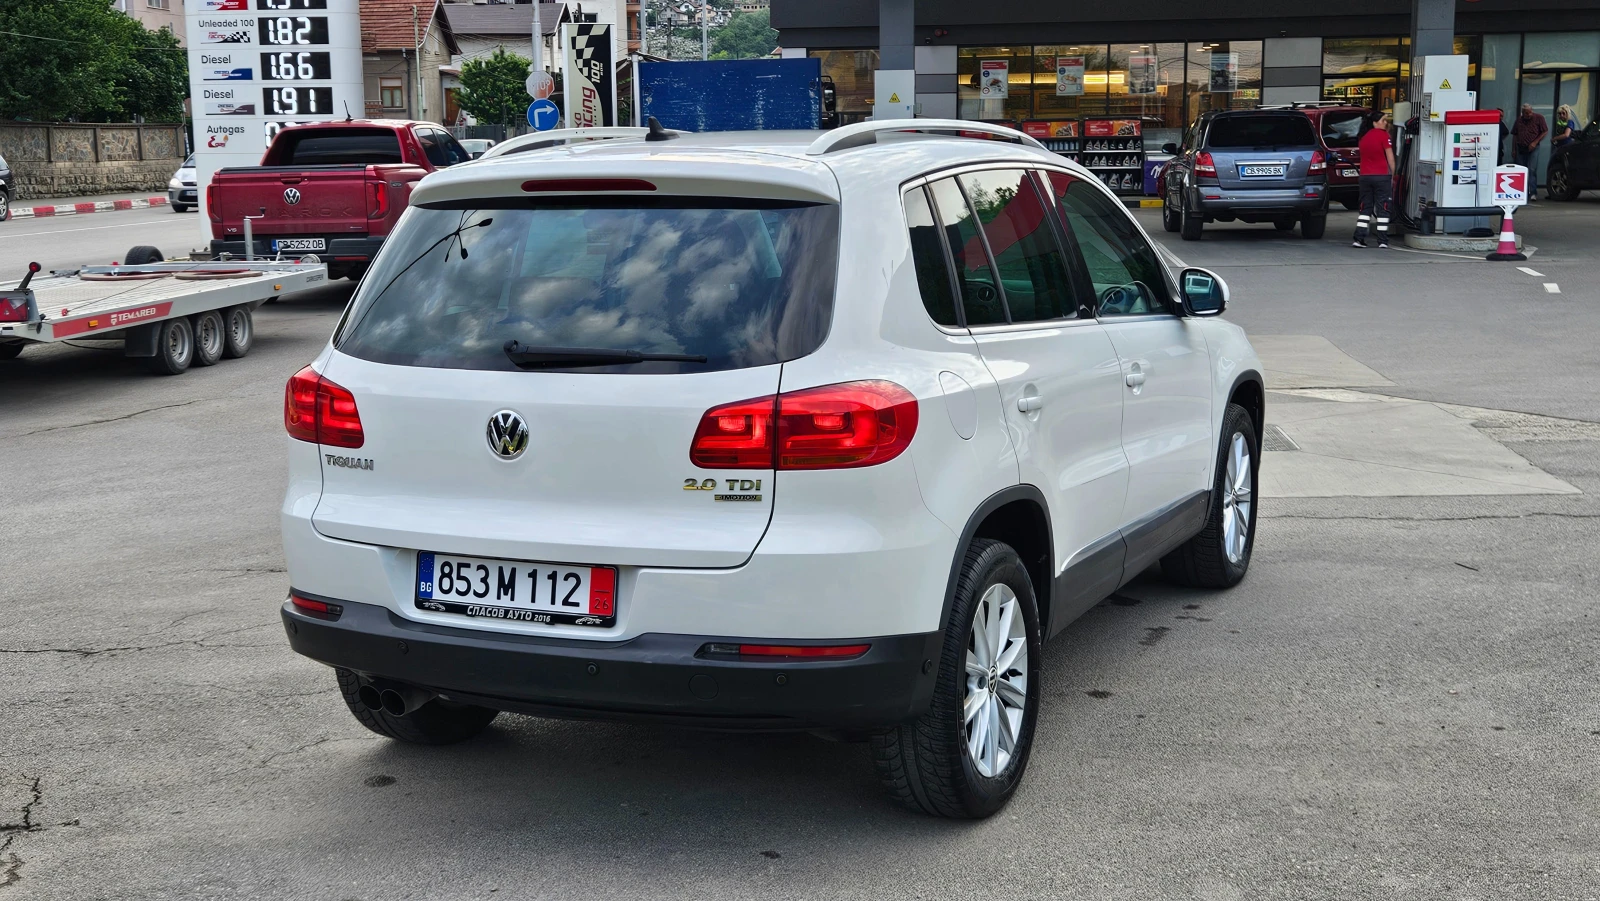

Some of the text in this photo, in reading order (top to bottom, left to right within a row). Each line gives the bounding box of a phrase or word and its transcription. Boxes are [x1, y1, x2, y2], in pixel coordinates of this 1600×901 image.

[198, 19, 255, 28] Unleaded 100
[268, 17, 311, 45] 1.82
[201, 54, 232, 64] Diesel
[270, 52, 313, 80] 1.66
[590, 60, 600, 84] 100
[203, 89, 234, 99] Diesel
[272, 87, 316, 115] 1.91
[206, 125, 245, 135] Autogas
[289, 240, 311, 249] 5252
[118, 307, 156, 322] TEMARED
[325, 454, 374, 471] TIGUAN
[683, 478, 762, 491] 2.0 TDI
[420, 581, 432, 593] BG
[438, 561, 582, 608] 853 M 112
[594, 597, 609, 610] 26
[467, 604, 551, 623] СПАСОВ АУТО 2016
